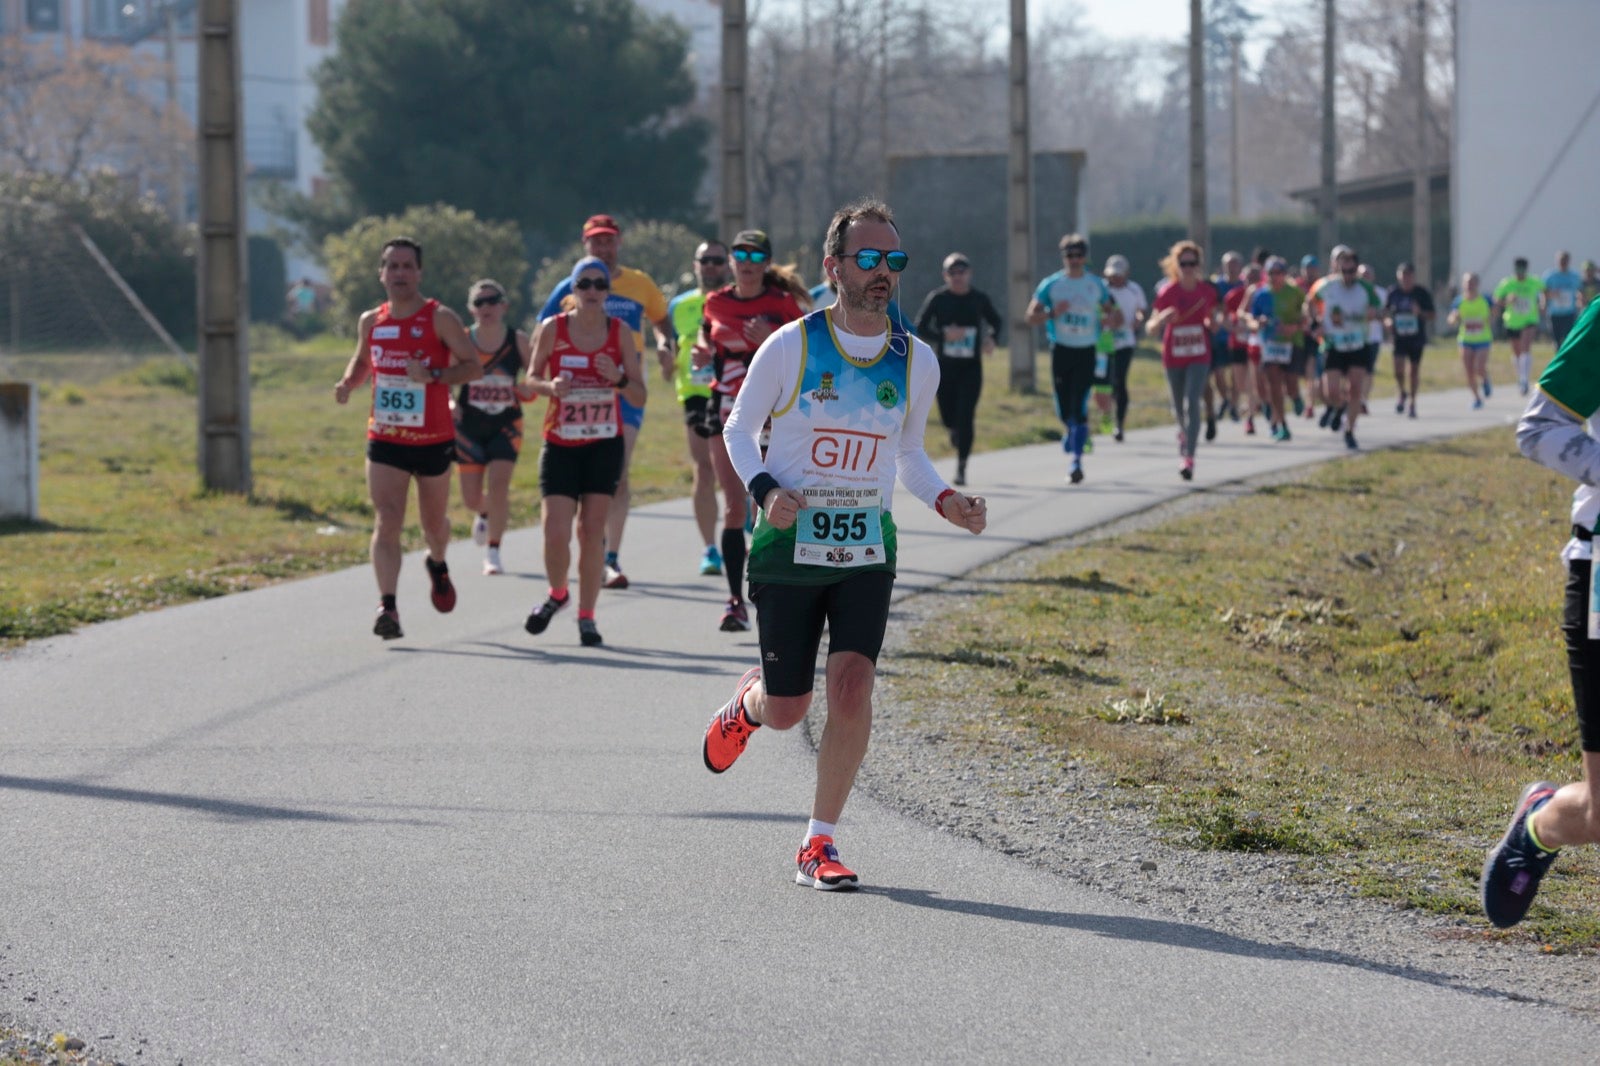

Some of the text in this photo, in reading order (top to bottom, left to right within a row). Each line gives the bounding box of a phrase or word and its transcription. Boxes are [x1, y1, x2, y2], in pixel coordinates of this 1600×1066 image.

[380, 390, 415, 411] 563
[471, 385, 512, 401] 2023
[564, 404, 613, 423] 2177
[819, 489, 835, 498] GRAN
[836, 489, 855, 498] PREMIO
[856, 489, 863, 498] DE
[863, 489, 878, 497] FONDO
[812, 511, 867, 542] 955
